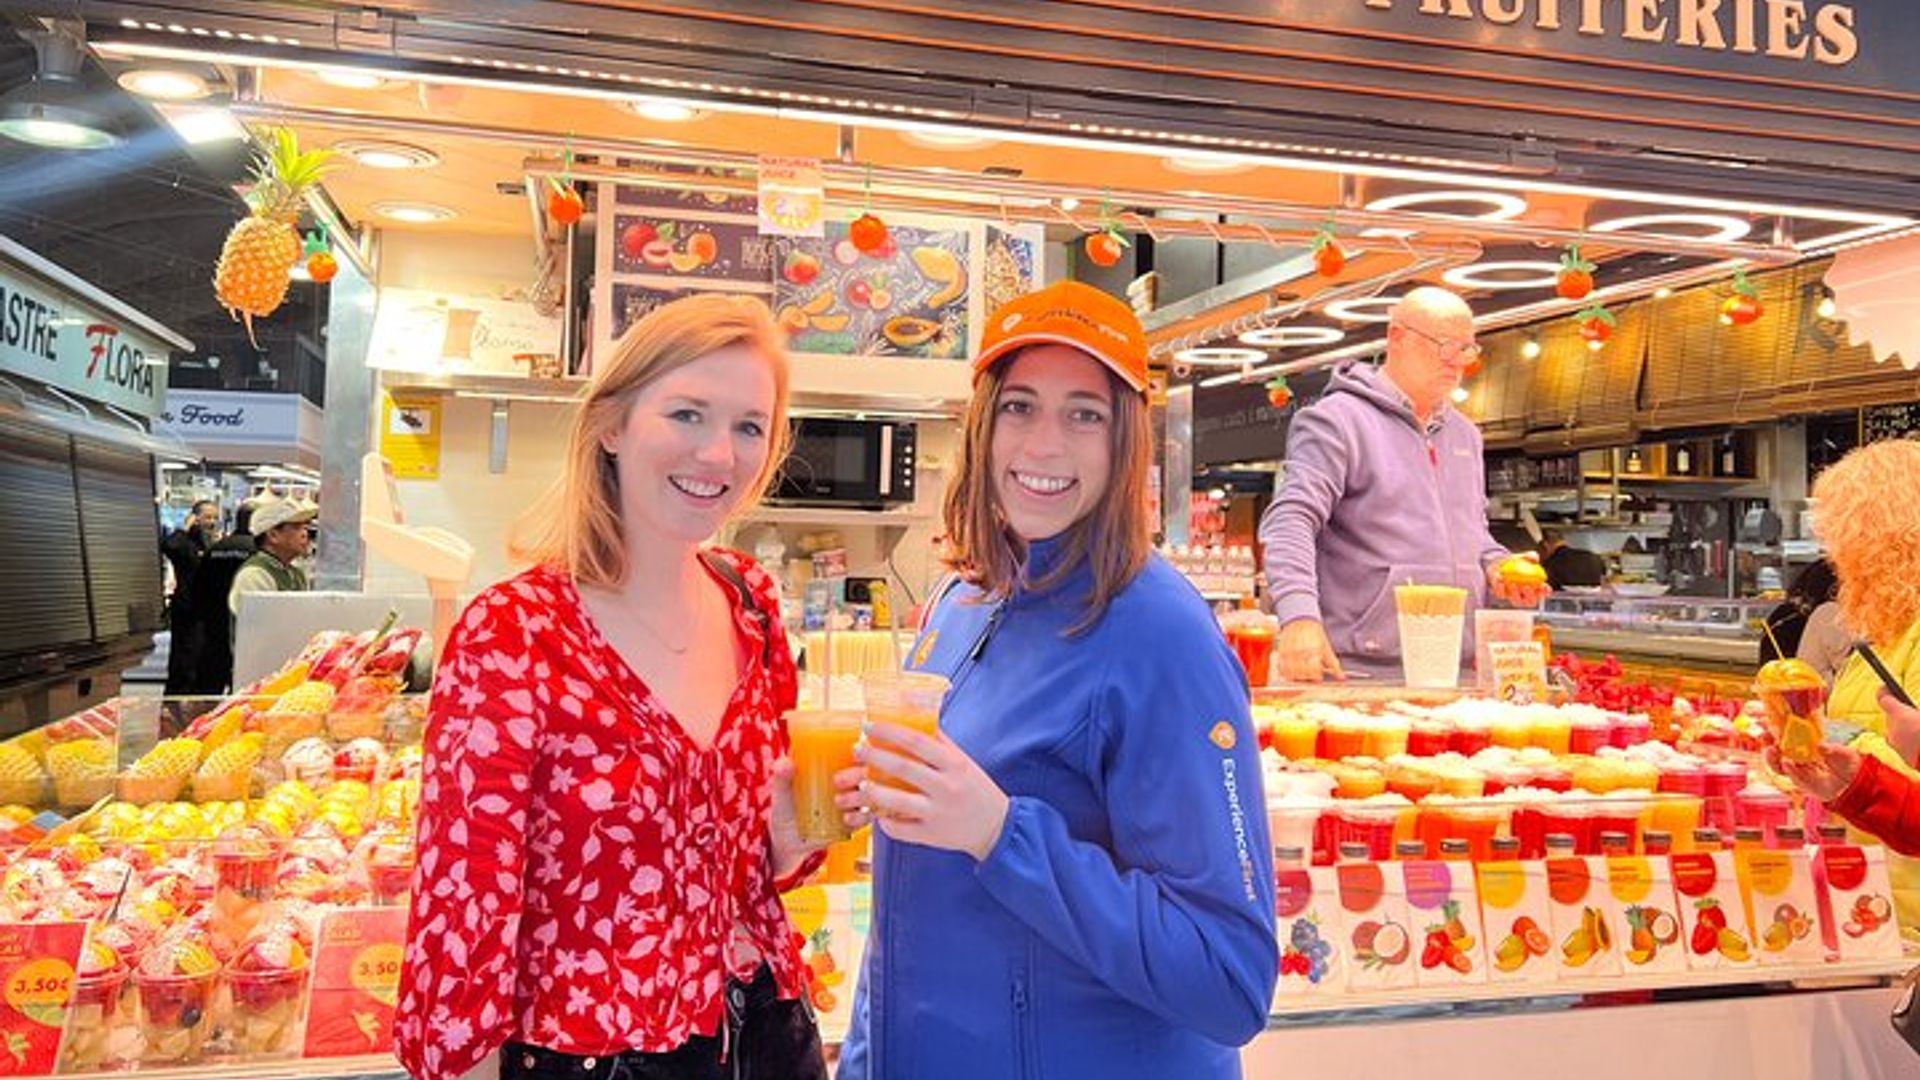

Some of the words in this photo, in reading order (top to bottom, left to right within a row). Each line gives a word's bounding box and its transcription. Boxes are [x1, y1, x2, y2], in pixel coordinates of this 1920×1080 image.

[1365, 0, 1858, 65] UITERIES
[86, 324, 153, 399] FLORA
[181, 403, 244, 427] Food
